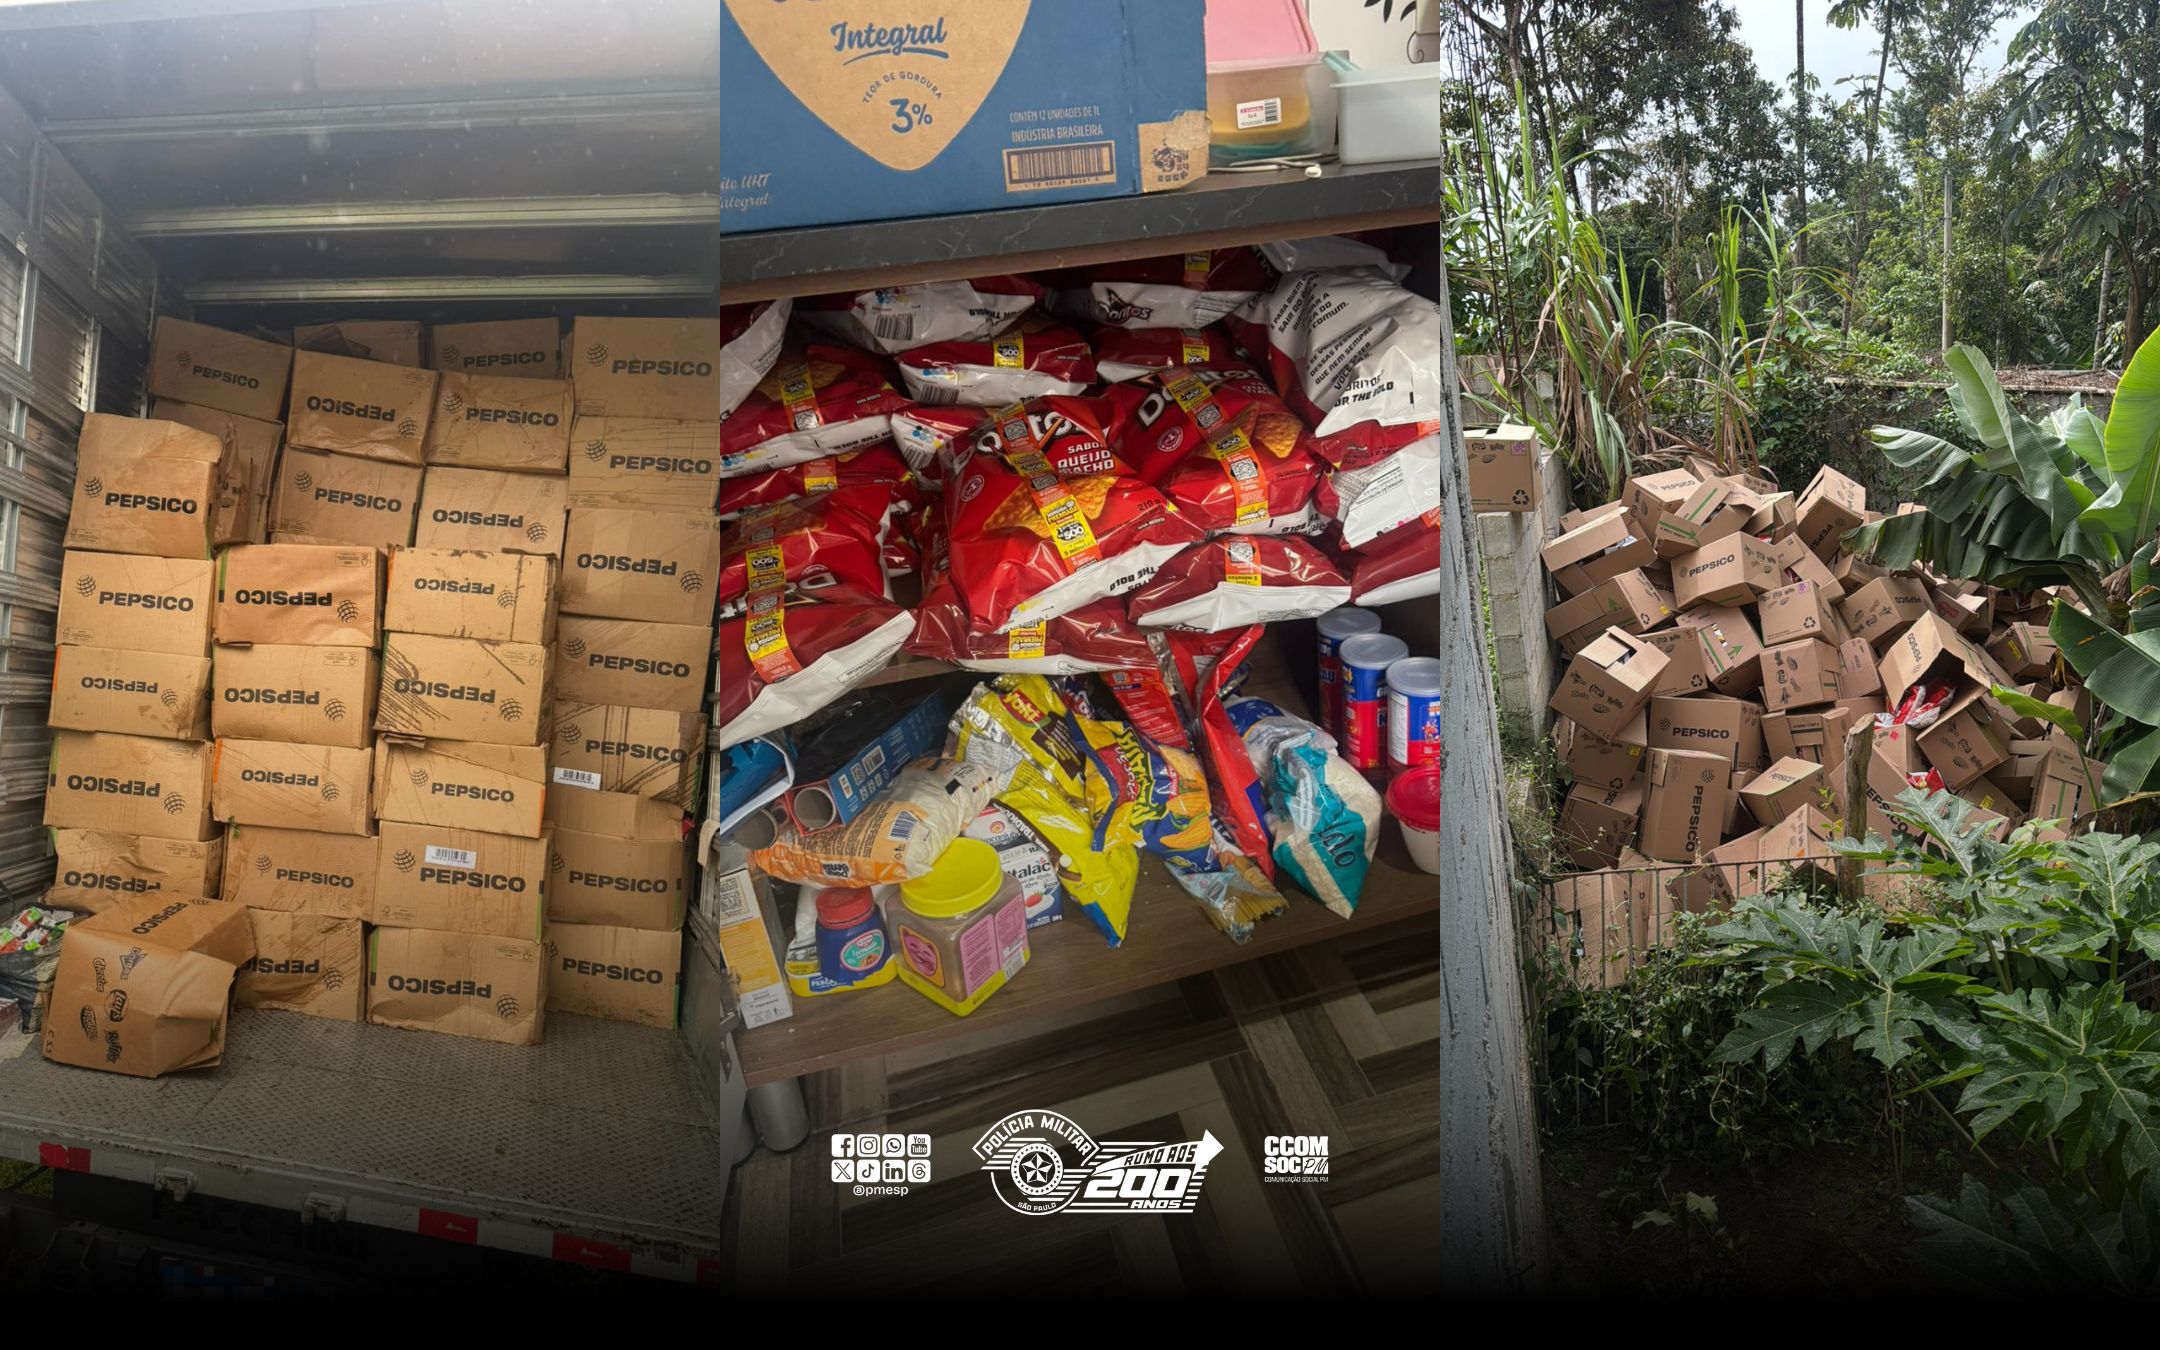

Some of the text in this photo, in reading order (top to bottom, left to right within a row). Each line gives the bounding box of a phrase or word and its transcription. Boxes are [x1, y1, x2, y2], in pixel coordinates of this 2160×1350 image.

[830, 17, 947, 55] Integral
[862, 71, 942, 104] TEOR DE GORDURA
[889, 98, 933, 134] 3%
[1047, 106, 1082, 120] UNIDADES
[1083, 105, 1092, 117] DE
[1056, 123, 1104, 140] BRASILEIRA
[741, 172, 772, 189] UHT
[1273, 304, 1289, 324] PARA
[1287, 280, 1303, 304] QUEM
[1319, 301, 1332, 311] DO
[1278, 299, 1303, 334] SAIR DO
[1312, 301, 1349, 329] COMUM.
[463, 351, 545, 369] PEPSICO
[1310, 350, 1336, 378] DESSAS
[1315, 325, 1373, 385] QUE NEM SEMPRE
[192, 364, 260, 390] PEPSICO
[611, 360, 712, 377] PEPSICO
[1352, 390, 1371, 403] THE
[1372, 380, 1394, 398] BOLD
[307, 395, 395, 423] PEPSICO
[466, 408, 559, 427] PEPSICO
[1057, 449, 1111, 469] QUEIJO
[1067, 441, 1101, 454] SABO
[609, 455, 712, 475] PEPSICO
[1660, 479, 1696, 492] PEPSICO
[105, 491, 198, 515] PEPSICO
[315, 487, 402, 513] PEPSICO
[1137, 499, 1153, 512] 210
[432, 508, 524, 529] PEPSICO
[1064, 525, 1085, 541] 500
[1810, 523, 1834, 550] PEPSI
[577, 553, 678, 577] PEPSICO
[1689, 553, 1735, 578] PEPSICO
[414, 577, 496, 596] PEPSICO
[1109, 573, 1135, 592] BOLD
[1137, 565, 1155, 579] THE
[99, 591, 194, 613] PEPSICO
[235, 589, 332, 607] PEPSICO
[1906, 632, 1922, 662] PEPSICO
[589, 653, 690, 678] PEPSICO
[81, 675, 158, 695] PEPSICO
[224, 687, 320, 706] PEPSICO
[394, 678, 496, 704] PEPSICO
[1672, 726, 1729, 740] PEPSICO
[585, 739, 687, 764] PEPSICO
[67, 774, 160, 798] PEPSICO
[241, 769, 319, 788] PEPSICO
[432, 782, 515, 803] PEPSICO
[1684, 784, 1705, 853] PEPSICO
[276, 868, 354, 888] PEPSICO
[420, 866, 527, 893] PEPSICO
[568, 870, 669, 894] PEPSICO
[131, 902, 190, 935] PEPSICO
[249, 958, 320, 975] PEPSI
[561, 957, 664, 986] PEPSICO
[388, 975, 492, 999] PEPSICO
